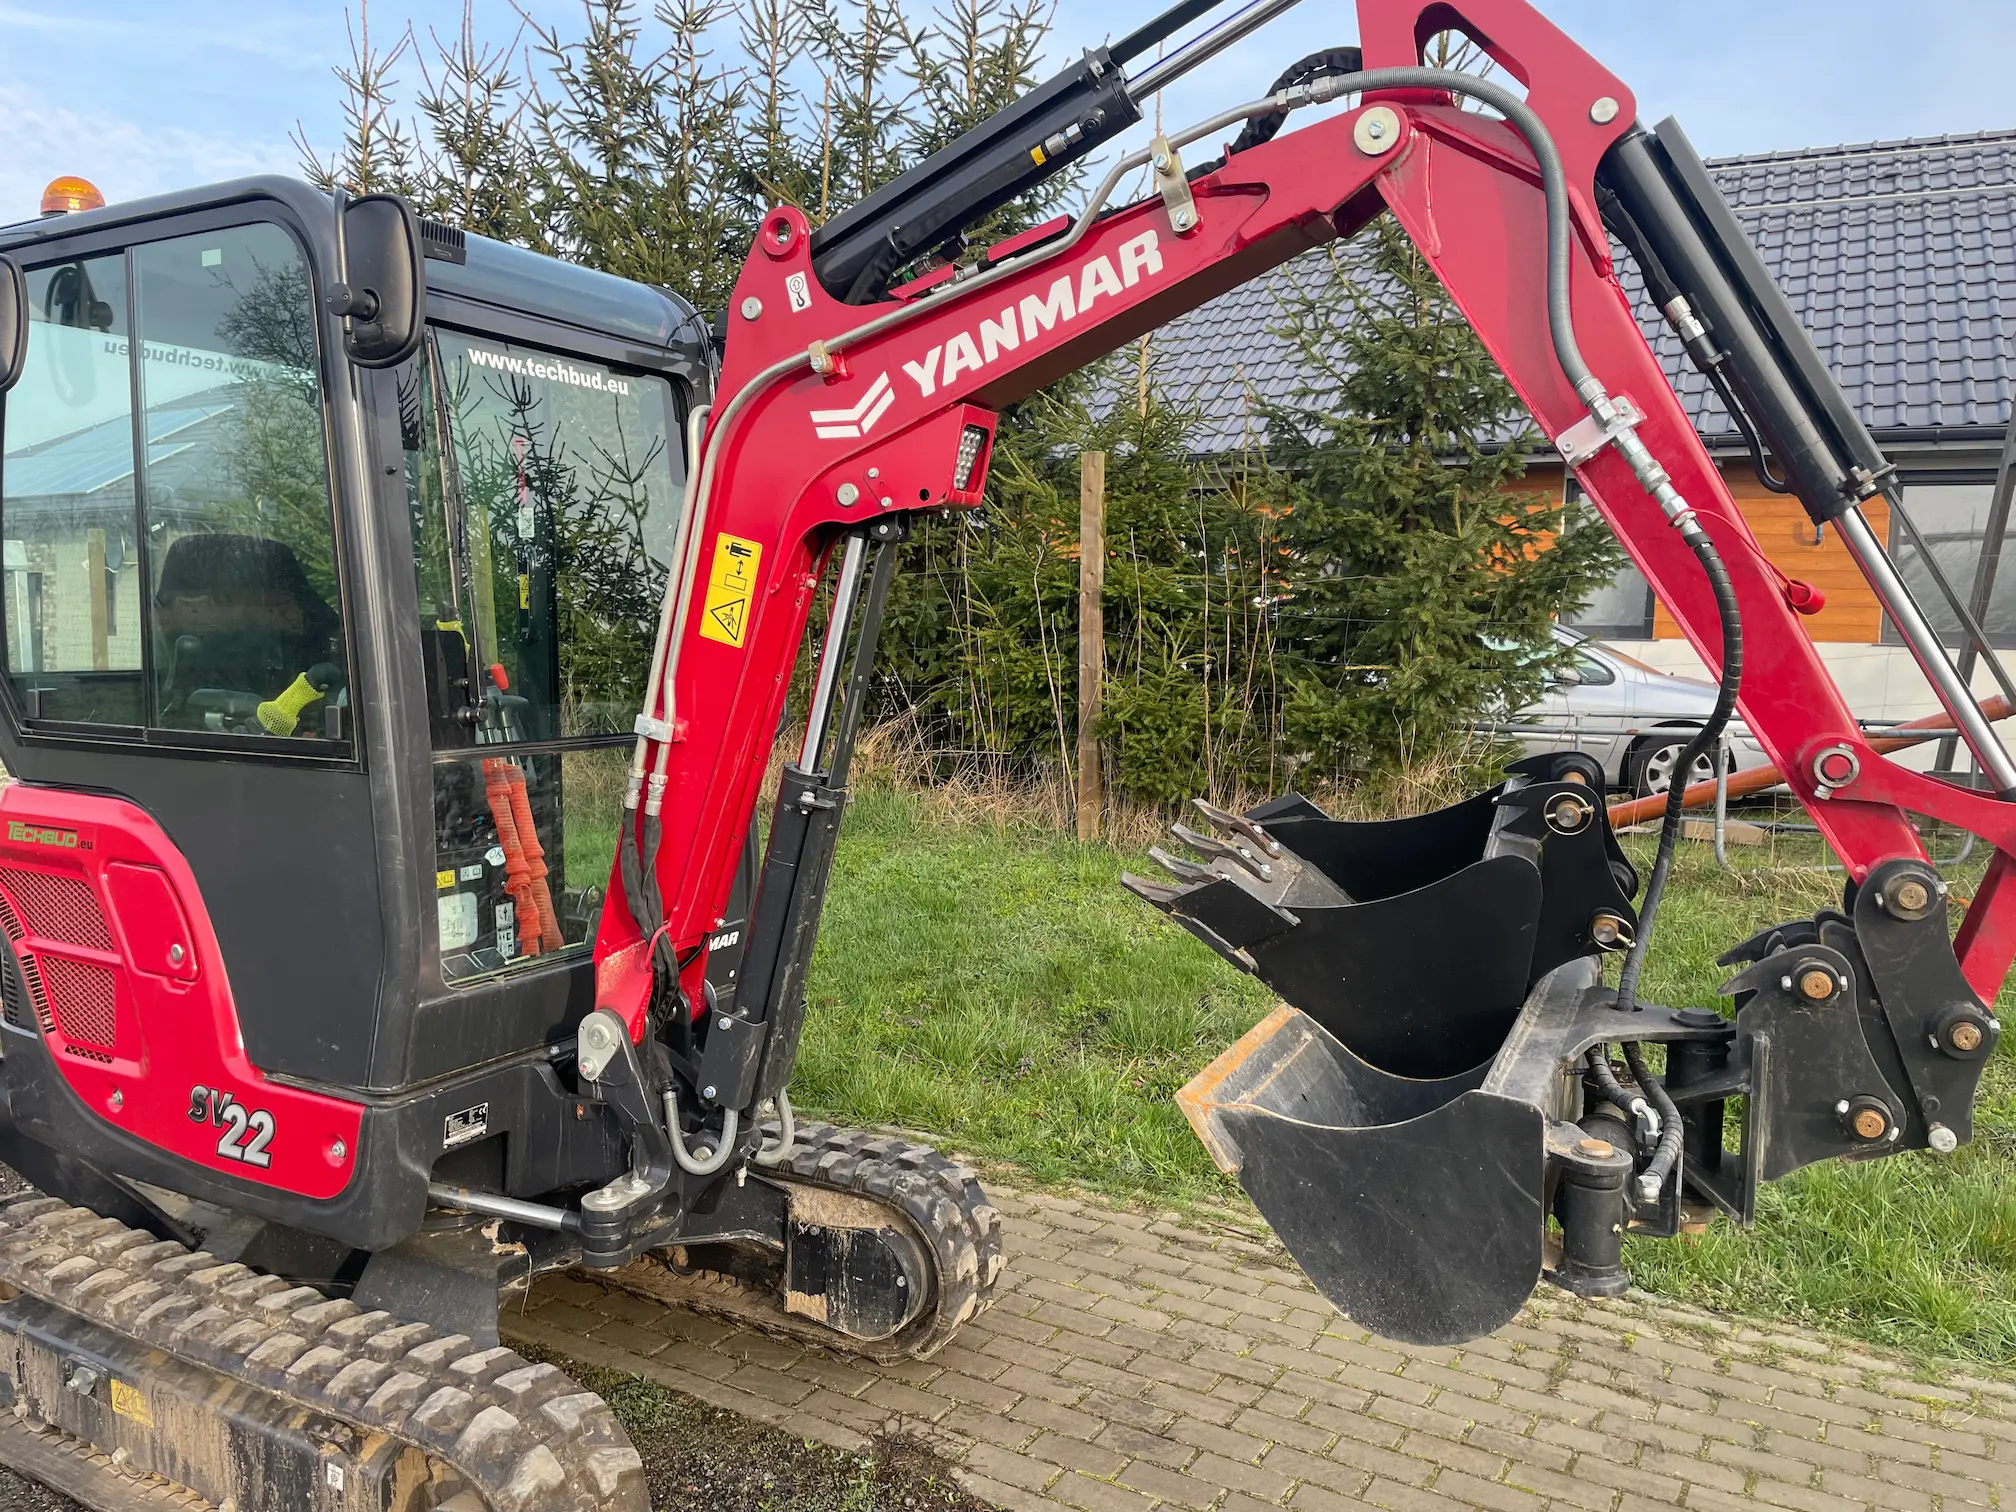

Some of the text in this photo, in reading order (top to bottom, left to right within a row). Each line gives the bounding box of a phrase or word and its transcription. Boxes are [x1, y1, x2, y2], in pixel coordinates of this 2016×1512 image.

[901, 229, 1164, 398] YANMAR
[467, 347, 629, 396] www.techbud.eu
[7, 820, 94, 850] TECHBUD.eu
[709, 930, 740, 952] MAR
